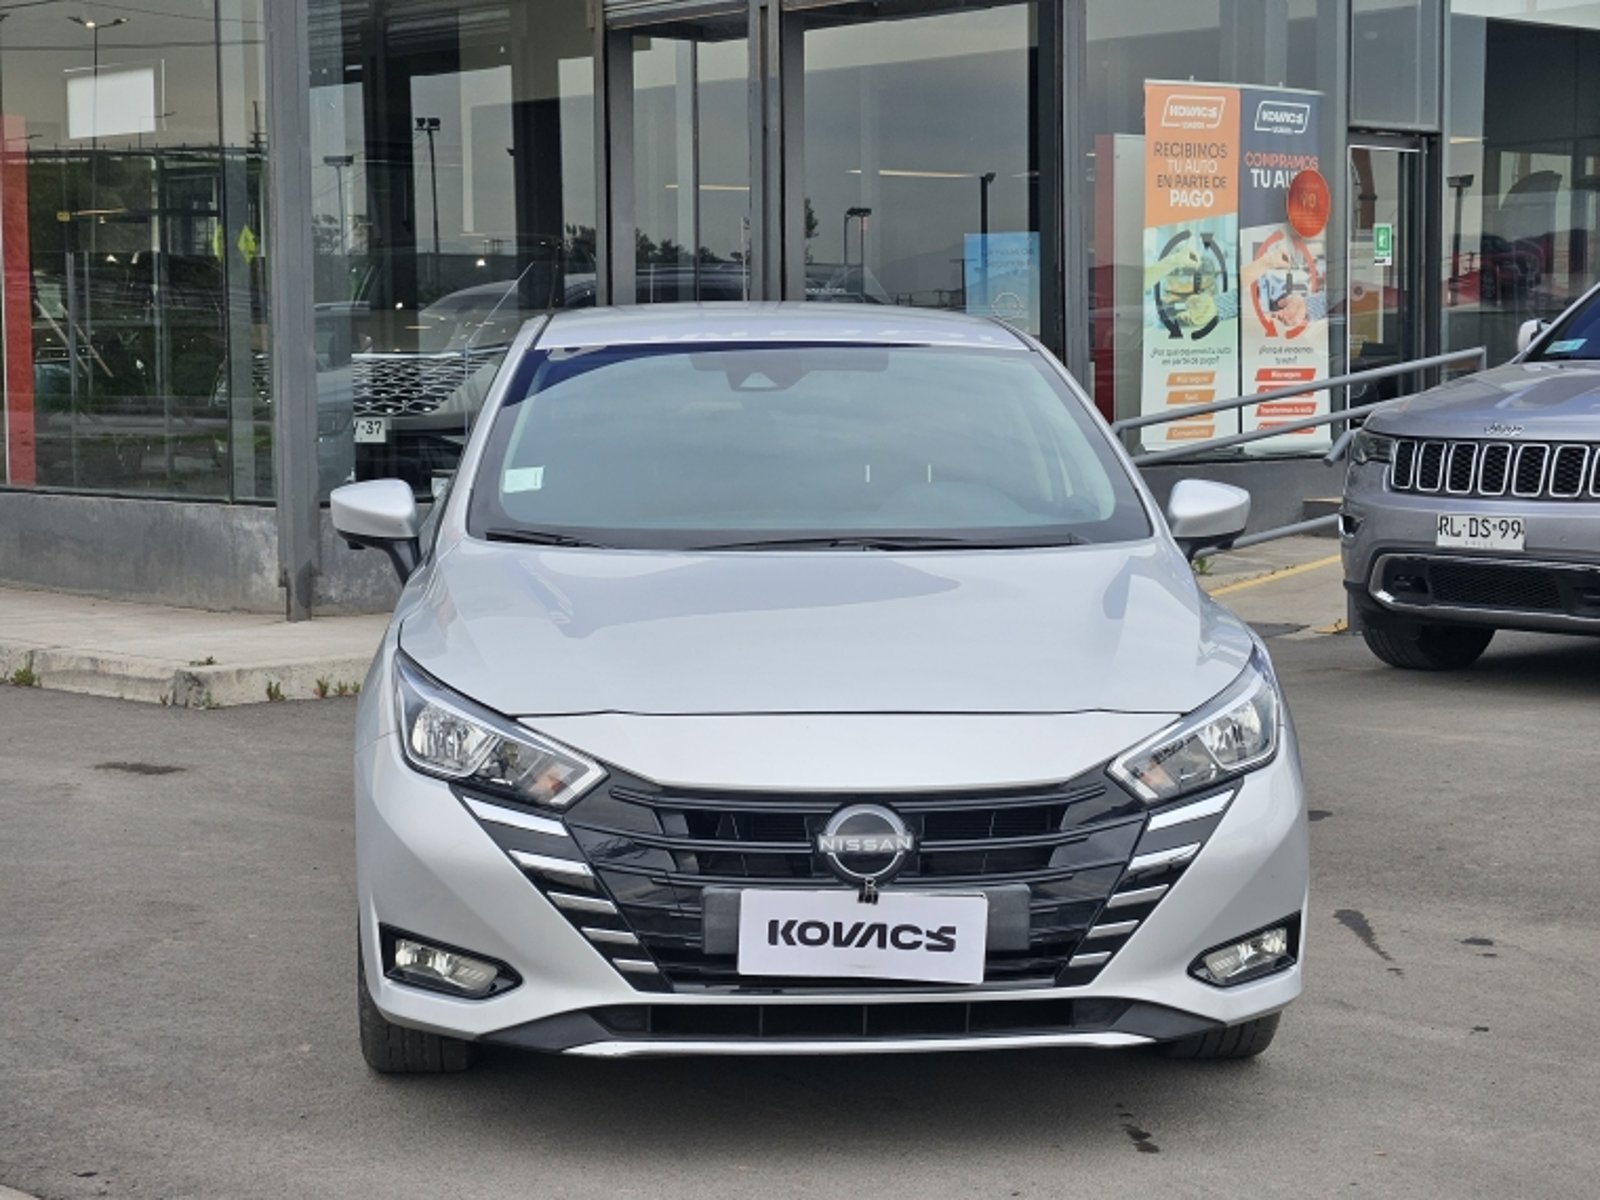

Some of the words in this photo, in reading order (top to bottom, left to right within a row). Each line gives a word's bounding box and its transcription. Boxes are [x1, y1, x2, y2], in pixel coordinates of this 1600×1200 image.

[1153, 142, 1228, 158] RECIBIMOS
[1167, 159, 1182, 172] TU
[1184, 160, 1218, 174] AUTO
[1244, 152, 1319, 169] COMPRAMOS
[1157, 174, 1172, 188] EN
[1175, 175, 1209, 188] PARTE
[1212, 176, 1227, 188] DE
[1250, 168, 1270, 188] TU
[1169, 190, 1215, 208] PAGO
[819, 836, 912, 851] NISSAN
[767, 919, 957, 953] KOVACS
